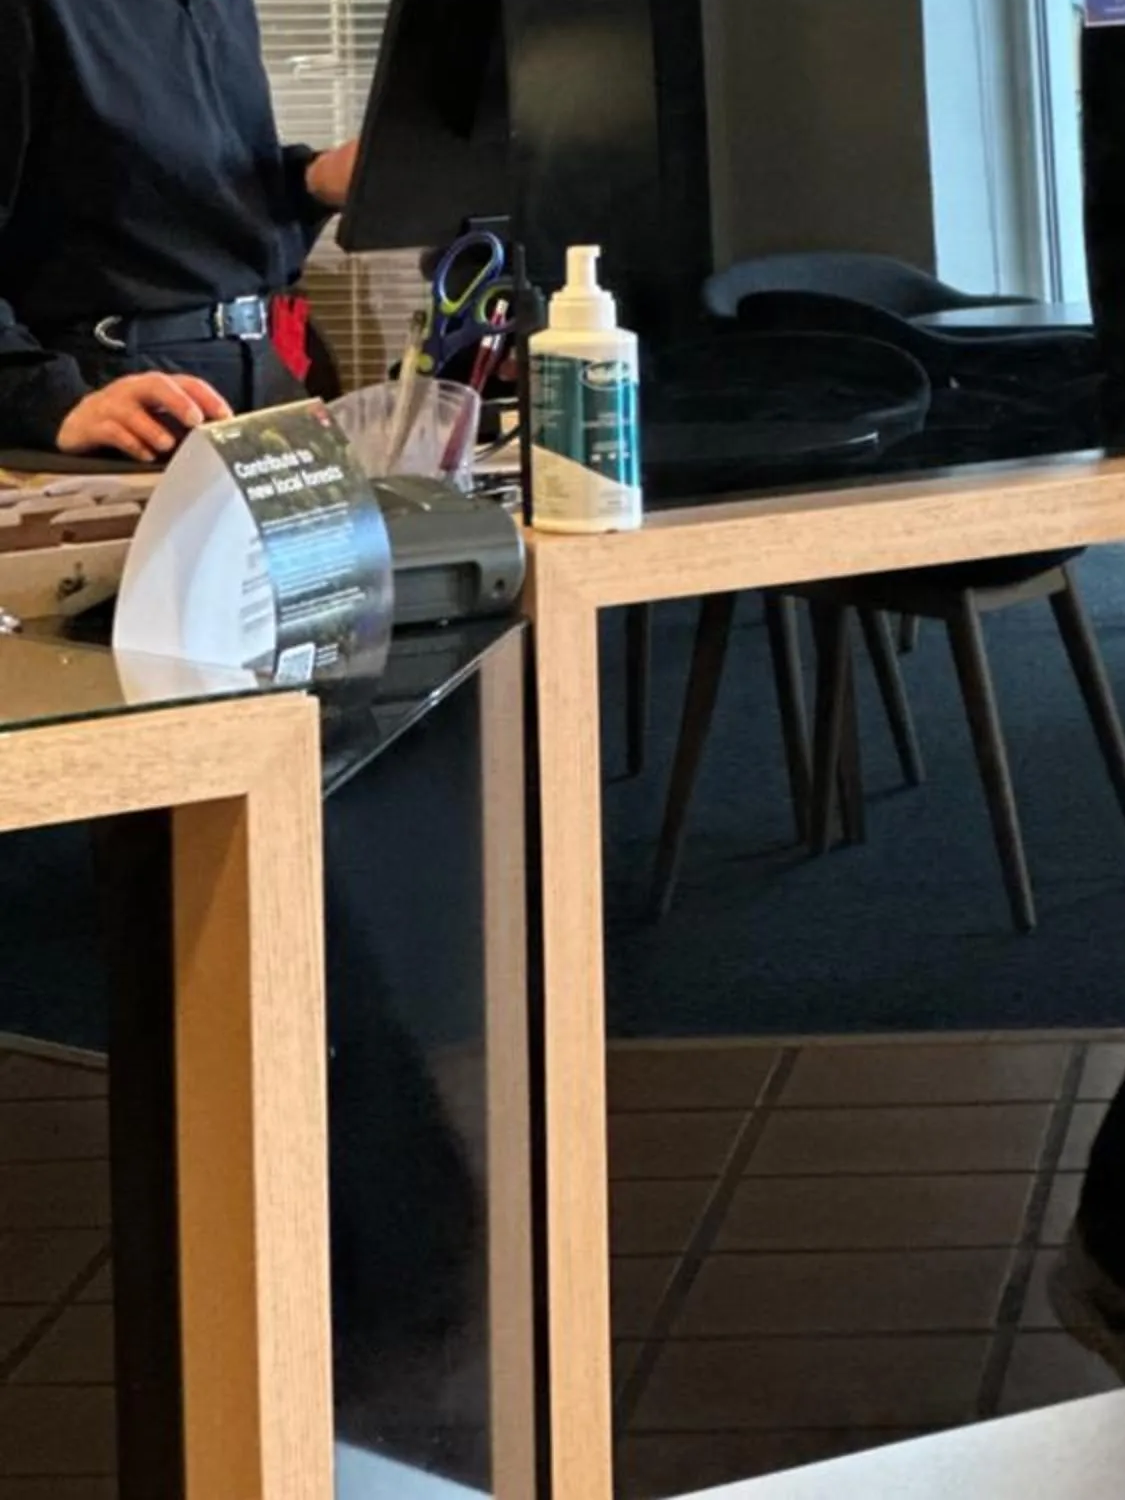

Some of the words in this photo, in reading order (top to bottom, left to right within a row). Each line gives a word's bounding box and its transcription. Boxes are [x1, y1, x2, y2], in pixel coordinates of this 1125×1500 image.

[233, 451, 299, 479] Contribute
[297, 449, 315, 464] to
[246, 484, 276, 501] new
[271, 473, 304, 495] local
[301, 465, 344, 488] forests
